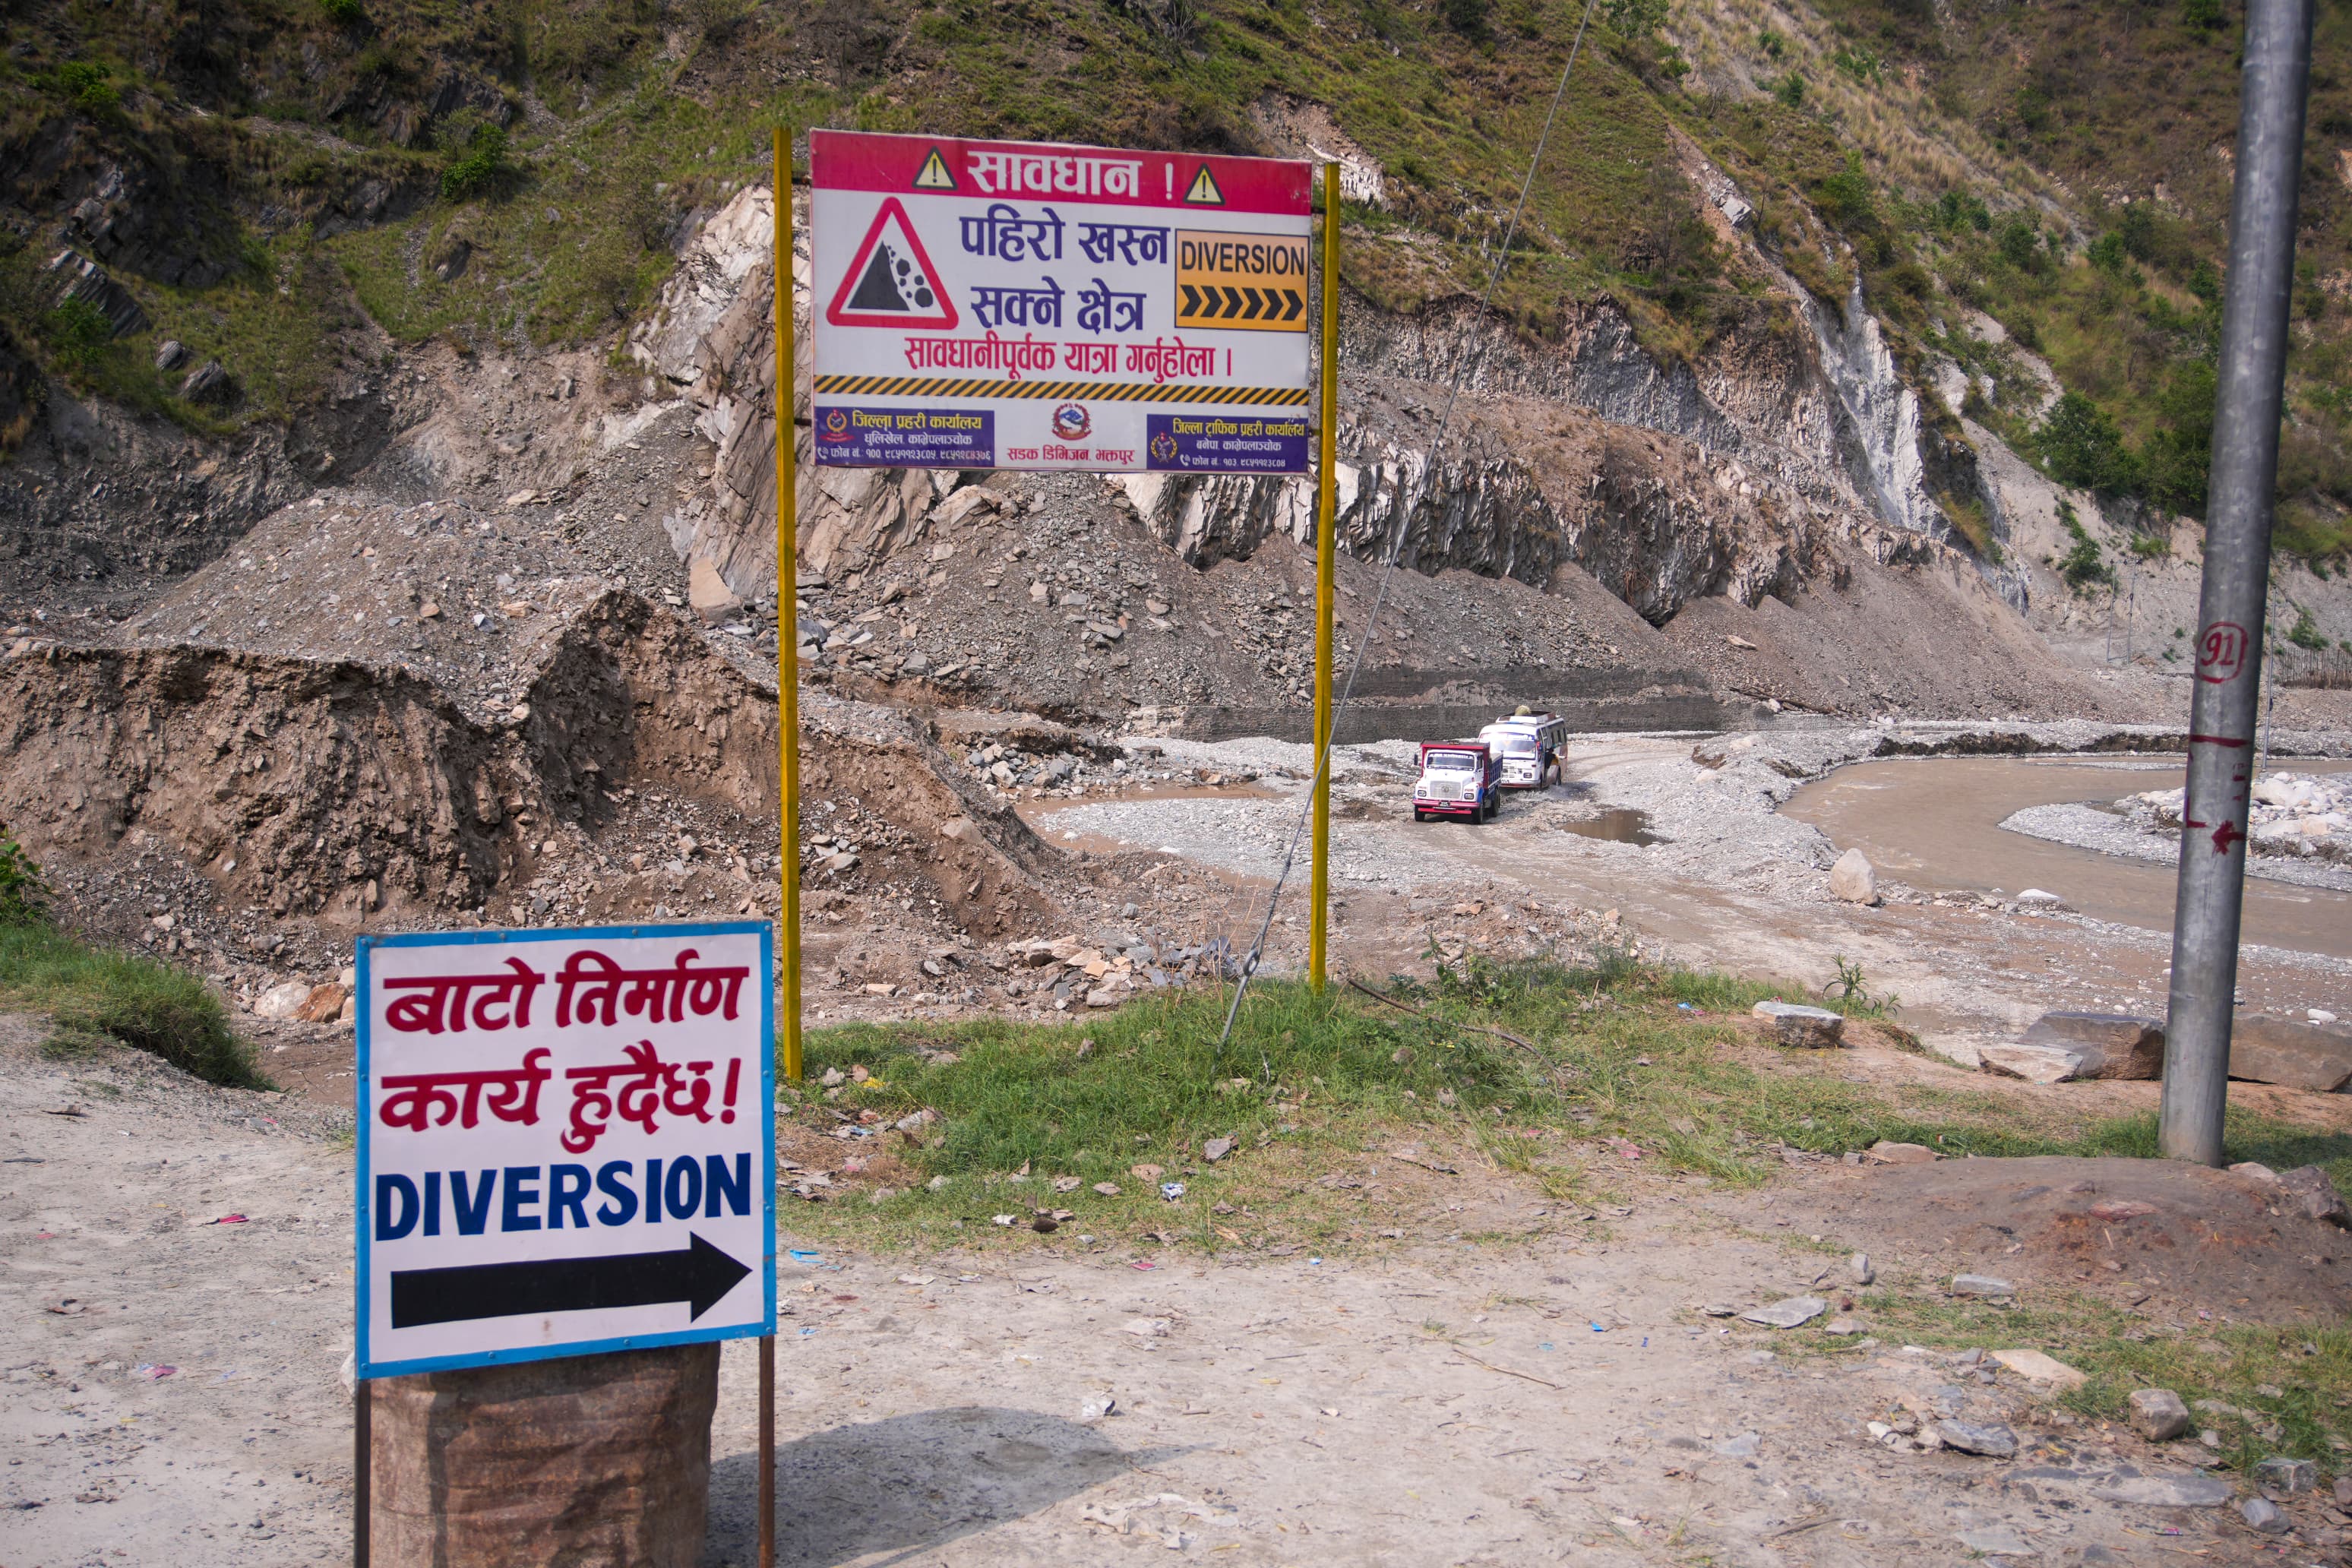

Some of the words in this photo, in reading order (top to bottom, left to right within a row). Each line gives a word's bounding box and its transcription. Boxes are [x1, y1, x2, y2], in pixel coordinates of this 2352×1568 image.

[967, 150, 1143, 198] सावधान
[959, 204, 1065, 261] पहिरो
[1079, 222, 1171, 266] खस्न
[1181, 240, 1305, 276] DIVERSION
[971, 276, 1064, 329] सक्ने
[1077, 278, 1146, 334] क्षेत्र
[904, 330, 1056, 380] सावधानीपूर्वक
[1064, 343, 1118, 374] यात्रा
[1127, 336, 1216, 383] गर्नुहोला
[852, 409, 892, 429] जिल्ला
[896, 413, 926, 430] प्रहरी
[930, 413, 982, 430] कार्यालय
[1173, 418, 1203, 435] जिल्ला
[1206, 419, 1238, 437] ट्राफिक
[1241, 420, 1263, 437] प्रहरी
[1265, 421, 1305, 437] कार्यालय
[830, 446, 849, 458] फोन
[1007, 447, 1038, 461] सडक
[1095, 448, 1136, 464] भक्तपुर
[1192, 455, 1209, 466] फोन
[2201, 631, 2235, 666] 91
[384, 956, 545, 1035] बाटो
[555, 948, 750, 1029] निर्माण
[379, 1048, 552, 1132] कार्य
[375, 1152, 752, 1241] DIVERSION
